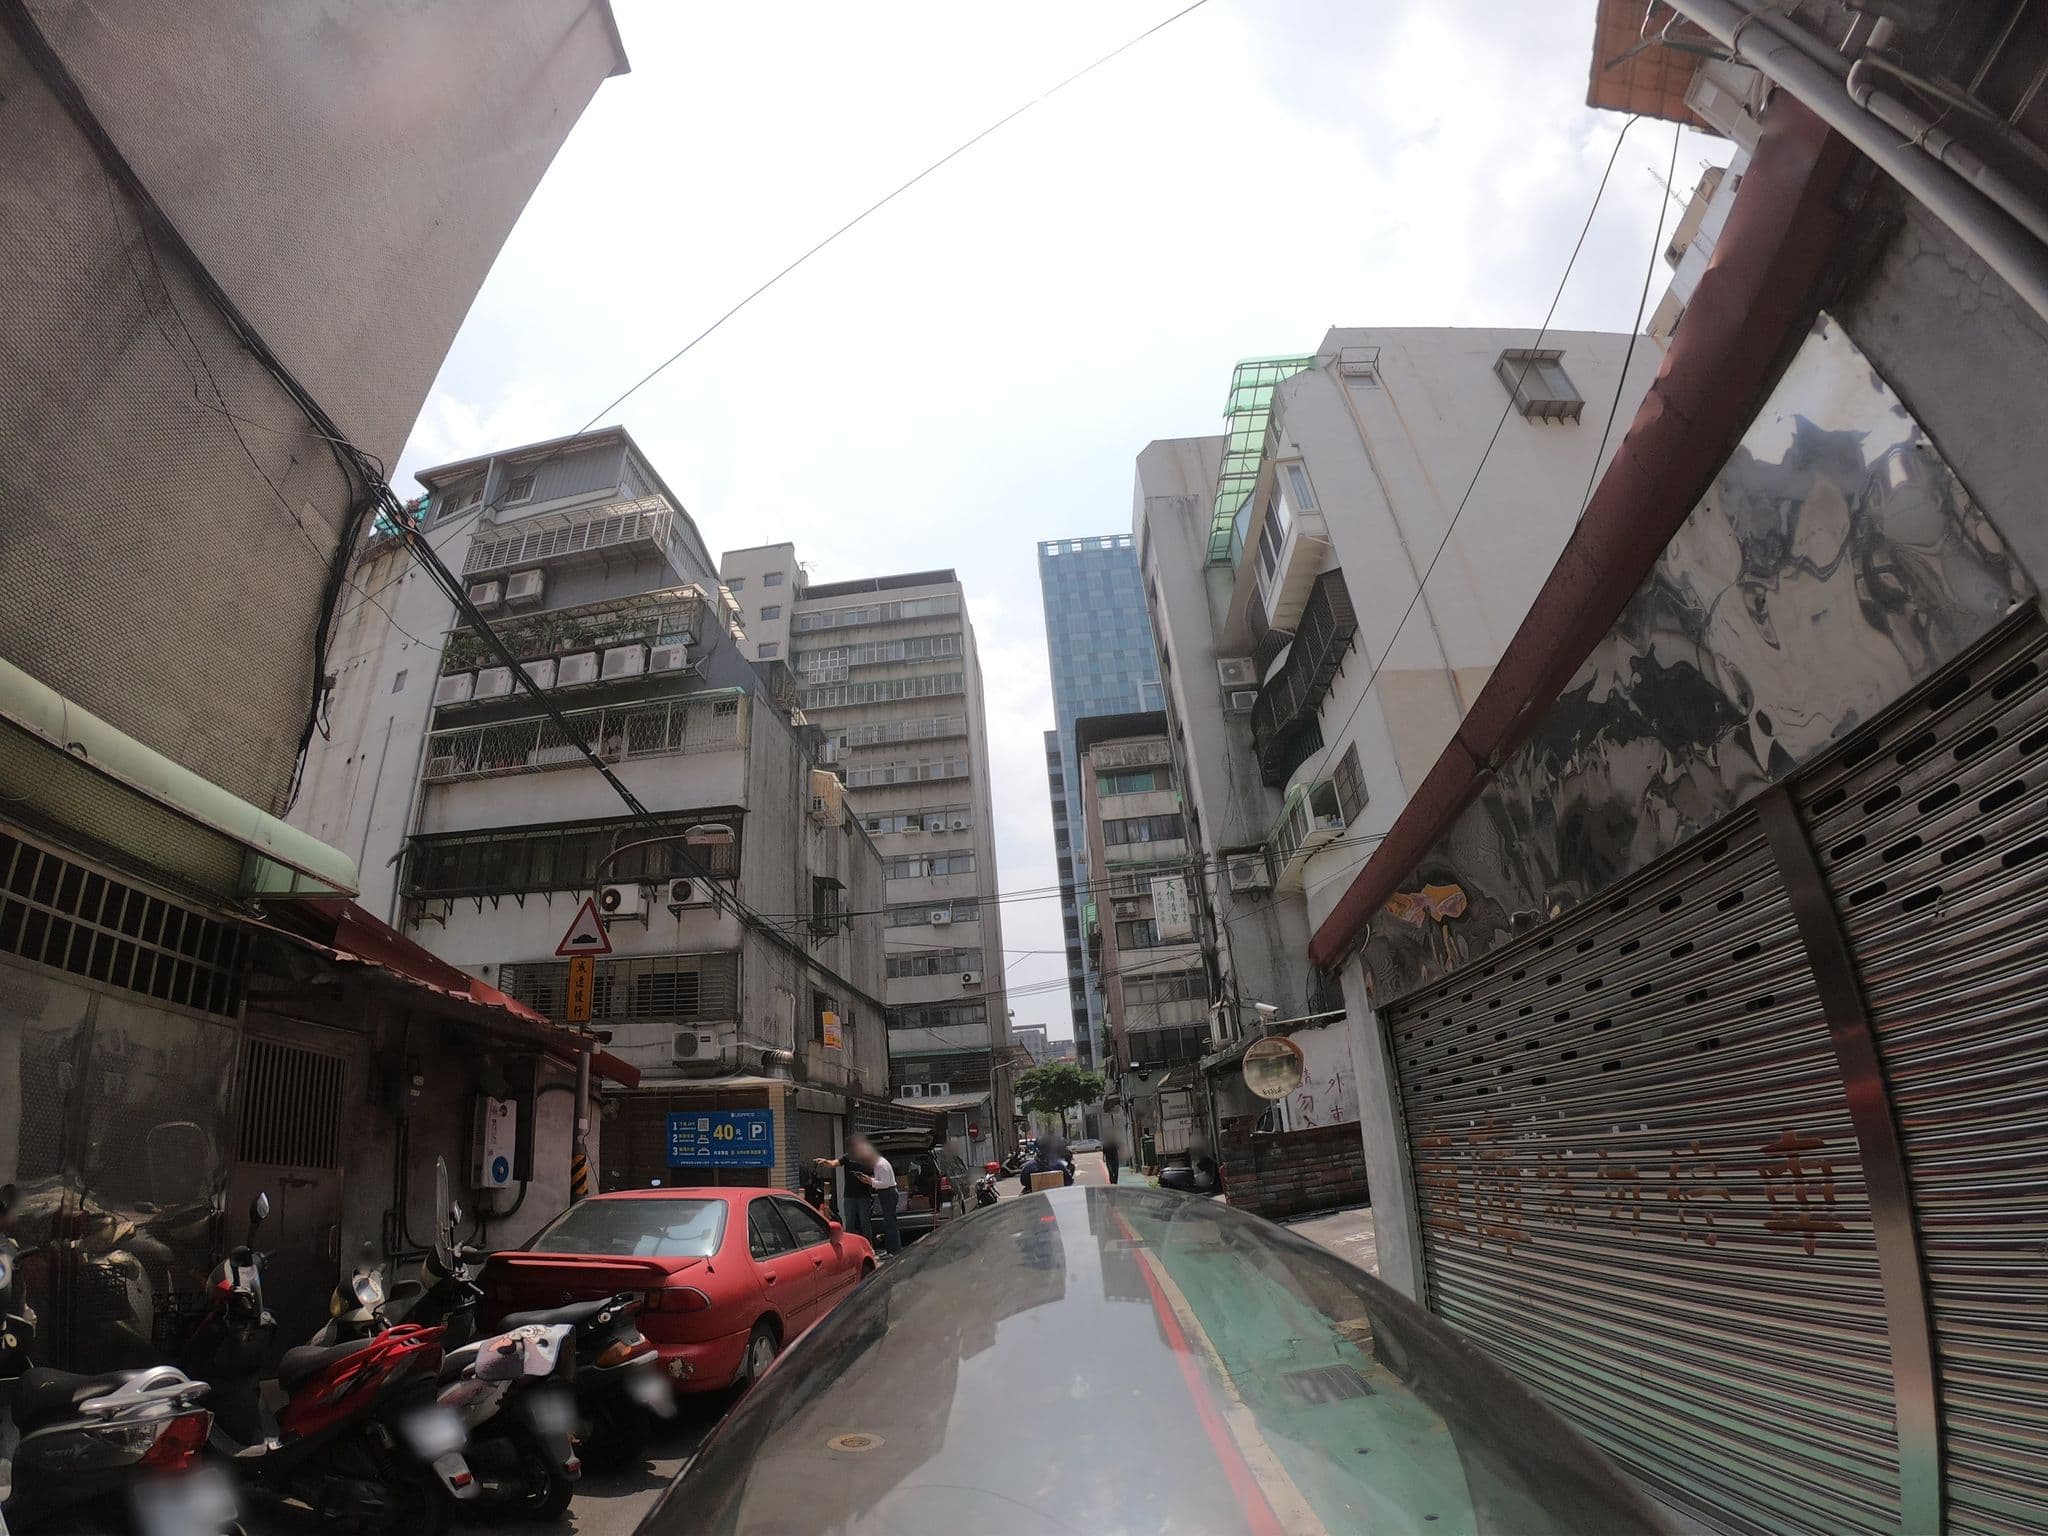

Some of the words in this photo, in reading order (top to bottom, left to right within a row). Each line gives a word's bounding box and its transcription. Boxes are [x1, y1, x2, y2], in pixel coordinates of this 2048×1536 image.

[573, 960, 587, 1017] 減速慢行
[672, 1133, 678, 1143] 2
[713, 1124, 734, 1140] 40
[751, 1124, 763, 1138] P
[672, 1146, 678, 1156] 3
